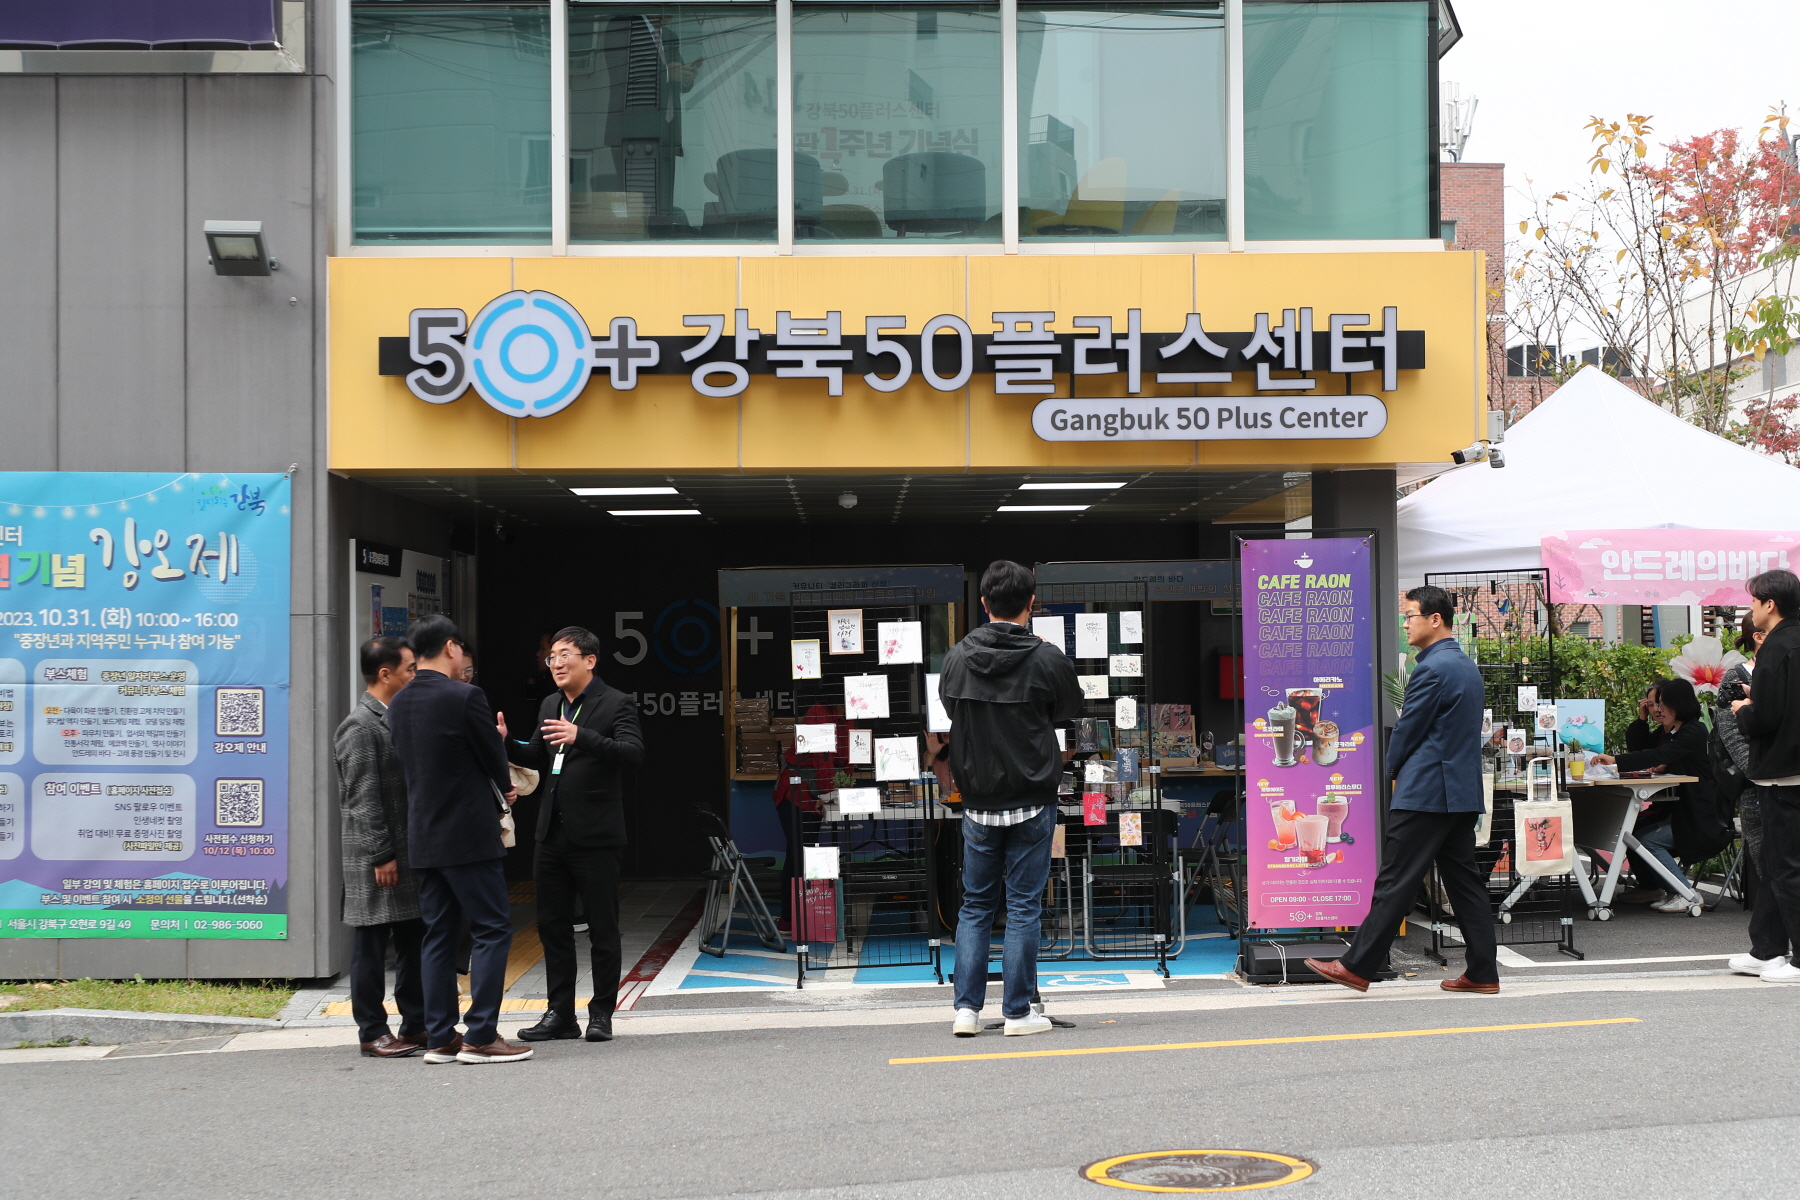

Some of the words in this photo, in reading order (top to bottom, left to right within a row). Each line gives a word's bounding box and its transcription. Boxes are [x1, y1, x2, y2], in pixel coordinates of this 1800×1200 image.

[806, 102, 940, 120] 강북50플러스센터
[773, 127, 892, 159] 관1주년
[899, 128, 978, 156] 기념식
[681, 306, 1398, 398] 강북50플러스센터
[1050, 408, 1169, 437] Gangbuk
[1176, 408, 1211, 430] 50
[1217, 406, 1273, 430] Plus
[1279, 407, 1368, 430] Center
[229, 483, 265, 516] 강북
[0, 525, 22, 546] 터
[16, 550, 86, 588] 기념
[1601, 550, 1791, 581] 안드레의바다
[1258, 575, 1301, 589] CAFE
[1305, 574, 1351, 588] RAON
[1258, 591, 1302, 607] CAFE
[1305, 590, 1353, 606] RAON
[39, 609, 96, 626] 10.31.
[101, 607, 132, 628] (화)
[1259, 608, 1302, 624] CAFE
[1306, 607, 1354, 623] RAON
[1259, 625, 1303, 641] CAFE
[1307, 624, 1354, 640] RAON
[14, 634, 74, 649] "중장년과
[77, 634, 131, 649] 지역주민
[134, 635, 175, 649] 누구나
[178, 634, 205, 649] 참여
[208, 634, 241, 650] 가능"
[1259, 642, 1303, 658] CAFE
[1307, 642, 1354, 657] RAON
[45, 667, 88, 681] 부스체험
[101, 671, 126, 682] 중장년
[128, 671, 150, 682] 일자리
[152, 671, 169, 682] 부스
[119, 686, 151, 696] 커뮤니티
[166, 707, 185, 715] 만들기
[63, 730, 77, 738] 오후
[166, 730, 185, 738] 만들기
[166, 740, 185, 748] 이야기
[214, 742, 244, 754] 강오제
[246, 742, 267, 754] 안내
[98, 750, 111, 758] 바다
[45, 782, 67, 796] 참여
[69, 782, 101, 796] 이벤트
[115, 803, 132, 812] SNS
[134, 803, 158, 812] 팔로우
[160, 803, 183, 812] 이벤트
[134, 816, 165, 825] 인생네컷
[167, 816, 182, 825] 촬영
[78, 829, 93, 839] 취업
[95, 829, 114, 839] 대비!
[116, 829, 132, 839] 무료
[134, 829, 165, 839] 증명사진
[167, 829, 182, 839] 촬영
[204, 834, 238, 844] 사전접수
[240, 834, 273, 844] 신청하기
[203, 846, 230, 856] 10/12
[249, 846, 275, 856] 10:00
[62, 879, 81, 891] 일부
[83, 879, 101, 891] 강의
[103, 879, 112, 891] 및
[114, 879, 142, 891] 체험은
[143, 879, 180, 891] 홈페이지
[182, 879, 210, 891] 접수로
[211, 879, 268, 891] 이루어집니다.
[41, 894, 60, 906] 부스
[62, 894, 72, 906] 및
[73, 894, 101, 906] 이벤트
[102, 894, 120, 906] 참여
[123, 894, 132, 906] 시
[136, 894, 164, 906] 소정의
[166, 894, 192, 906] 선물을
[8, 919, 36, 931] 서울시
[38, 919, 68, 931] 강북구
[69, 919, 98, 931] 오현로
[100, 919, 116, 931] 9길
[117, 919, 131, 931] 49
[150, 919, 180, 931] 문의처
[193, 919, 263, 931] 02-986-5060
